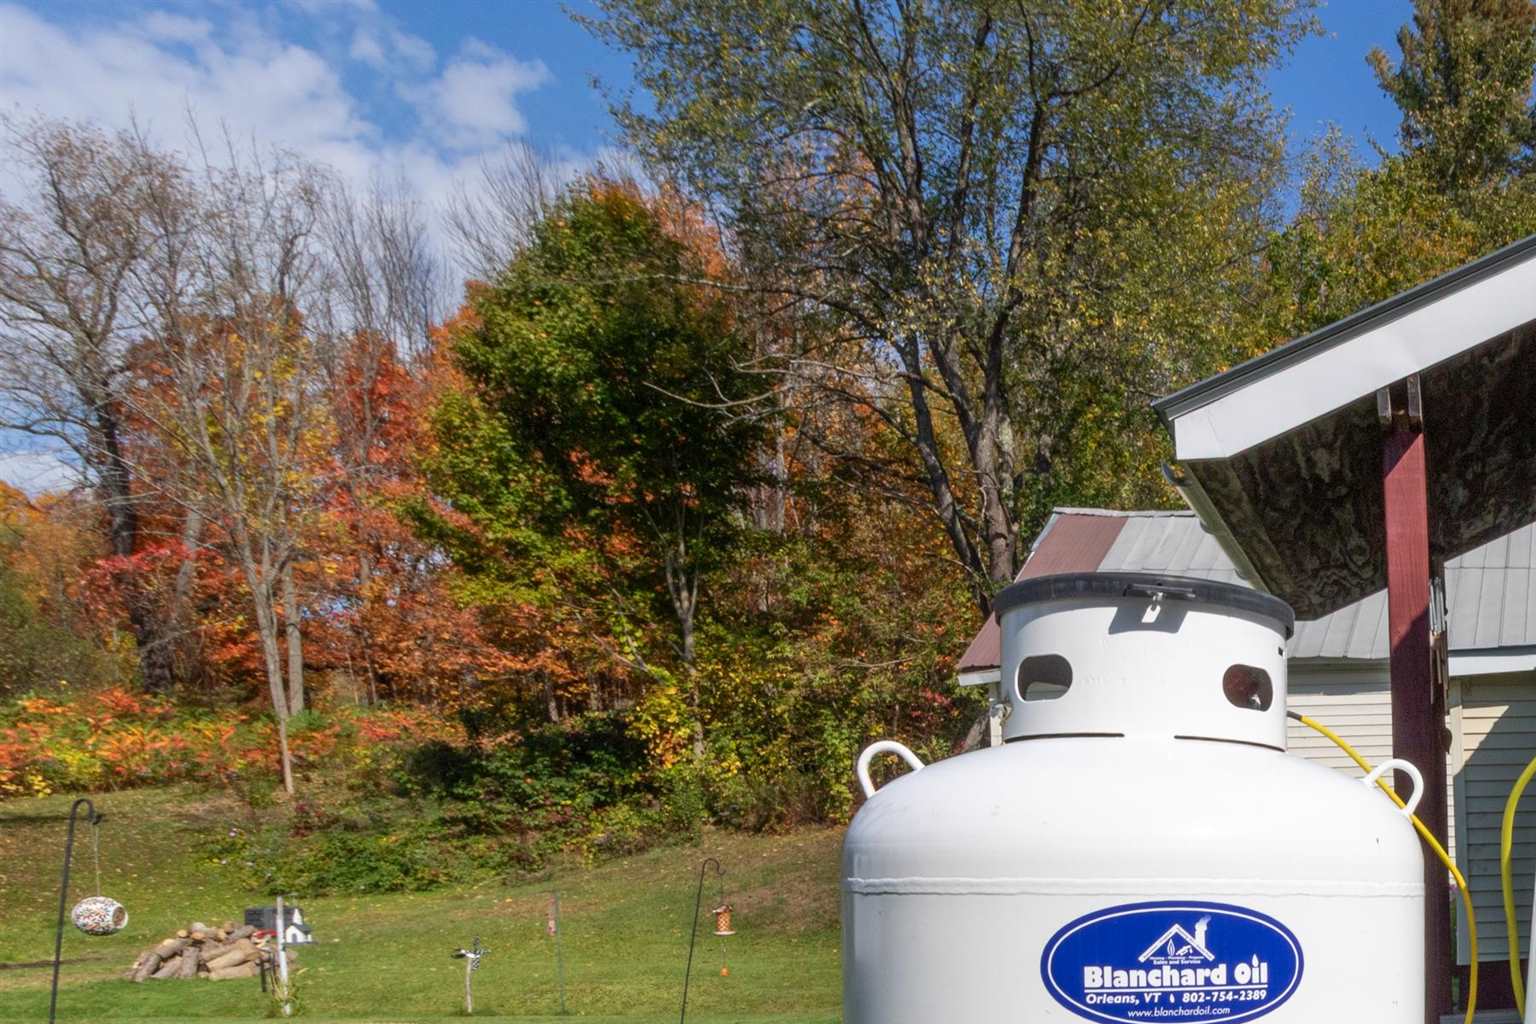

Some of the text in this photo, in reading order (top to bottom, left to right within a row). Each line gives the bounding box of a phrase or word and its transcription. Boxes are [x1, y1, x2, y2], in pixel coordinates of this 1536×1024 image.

[1084, 954, 1268, 988] Blanchard Oil
[1086, 990, 1267, 1005] Orleans, VT 802-754-2389
[1128, 1006, 1231, 1018] www.blanchardoil.com
